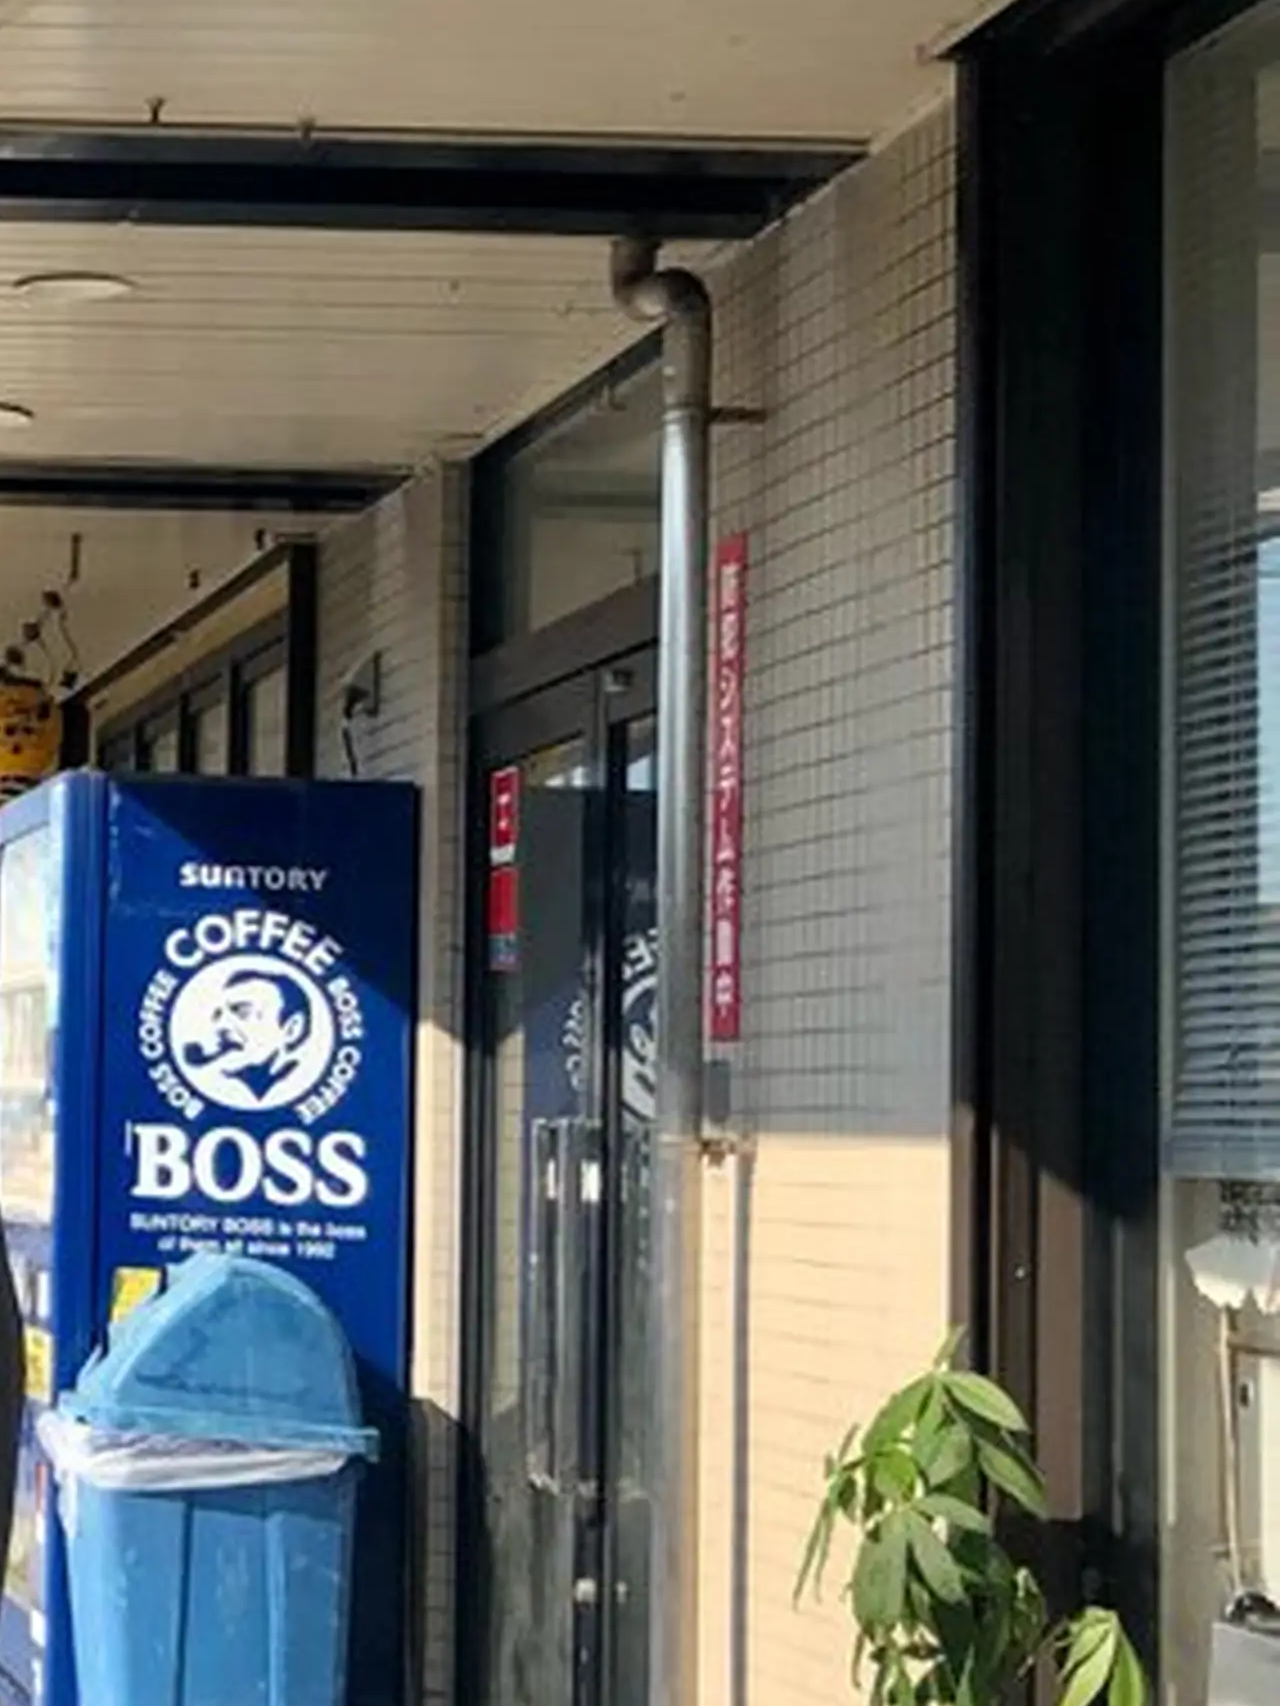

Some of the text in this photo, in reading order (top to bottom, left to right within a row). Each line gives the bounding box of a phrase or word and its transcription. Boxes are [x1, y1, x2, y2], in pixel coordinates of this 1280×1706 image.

[180, 862, 328, 891] SUNTORY
[165, 909, 342, 976] COFFEE
[139, 969, 177, 1059] COFFEE
[294, 976, 365, 1124] BOSS COFFEE
[130, 1123, 368, 1208] BOSS
